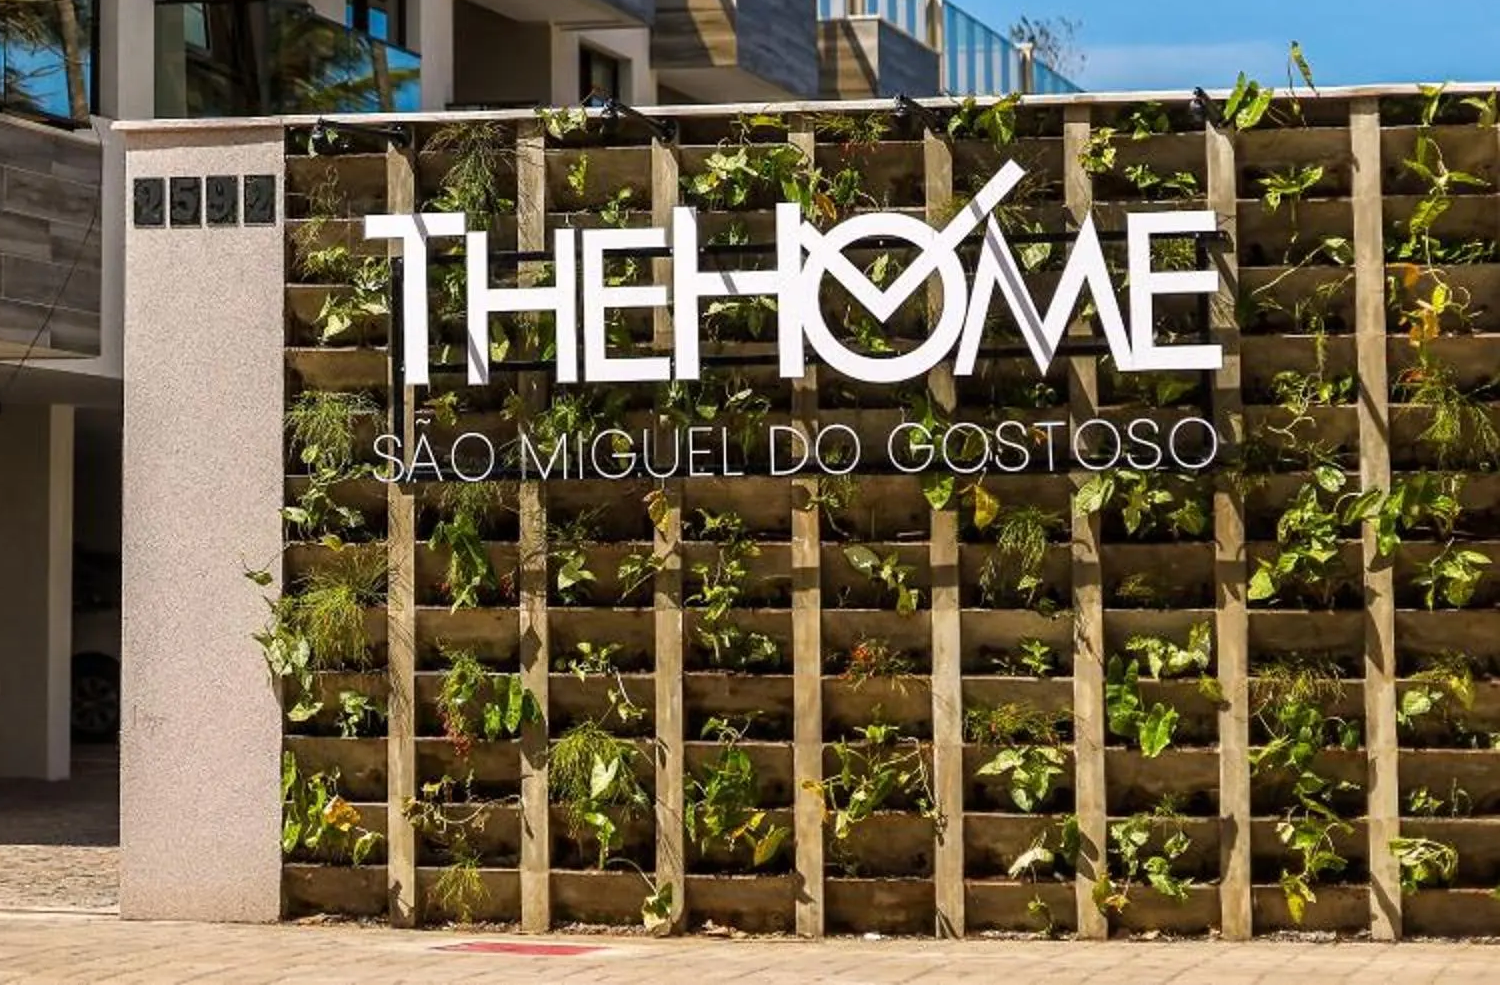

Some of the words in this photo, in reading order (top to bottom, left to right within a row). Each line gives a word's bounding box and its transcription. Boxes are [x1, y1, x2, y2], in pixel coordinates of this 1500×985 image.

[372, 418, 495, 483] SÃO
[521, 426, 745, 481] MIGUEL
[769, 423, 861, 476] DO
[887, 417, 1218, 474] GOSTOSO
